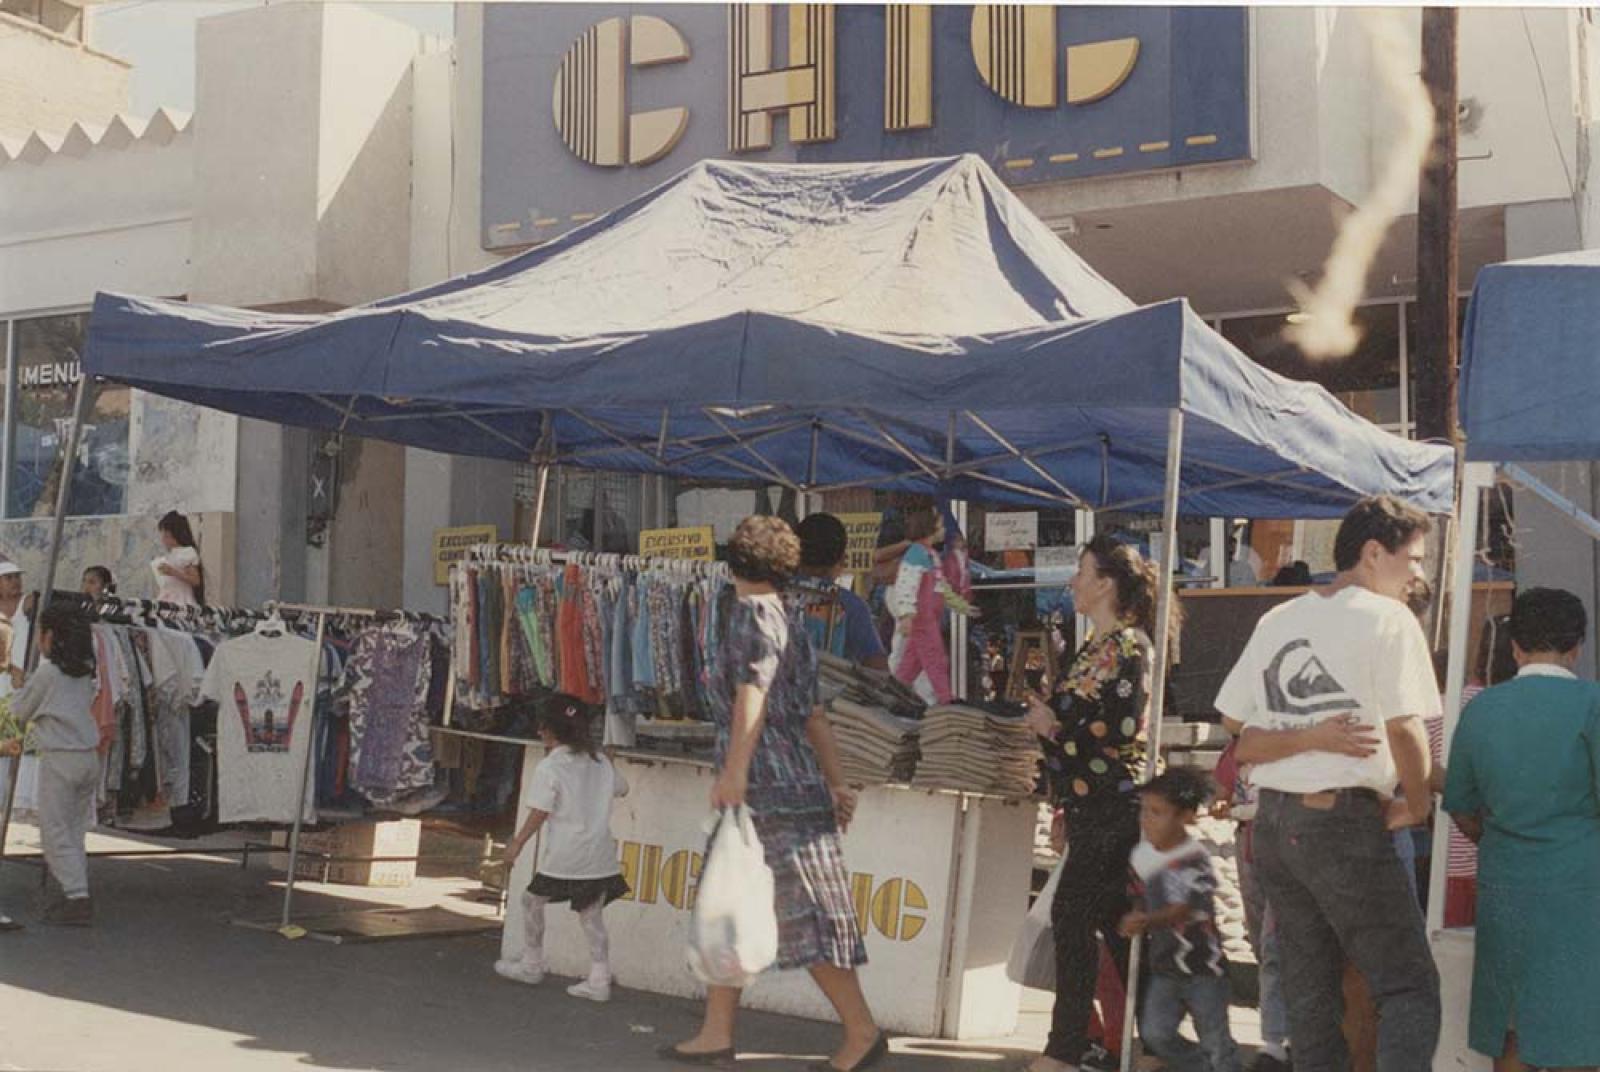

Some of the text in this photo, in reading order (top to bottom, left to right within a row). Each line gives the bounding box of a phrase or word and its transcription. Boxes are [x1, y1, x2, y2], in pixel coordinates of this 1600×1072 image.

[552, 5, 1140, 166] CHIC
[25, 362, 82, 385] MENU
[851, 871, 928, 941] IC
